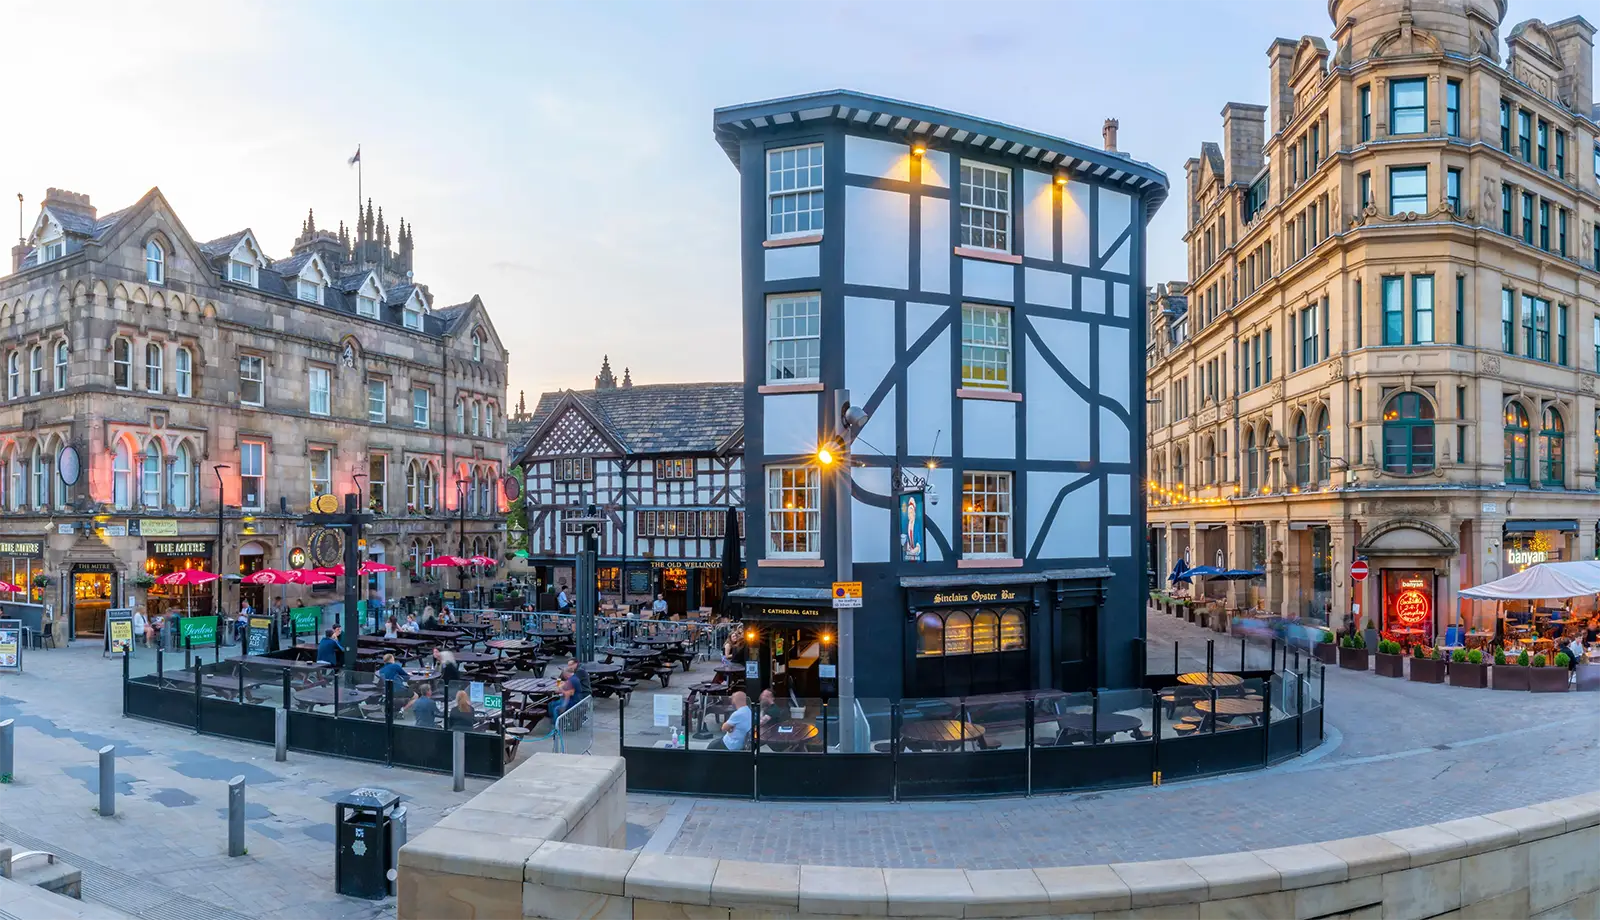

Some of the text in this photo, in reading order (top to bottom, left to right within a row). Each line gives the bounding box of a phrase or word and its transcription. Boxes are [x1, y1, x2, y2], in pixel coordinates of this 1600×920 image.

[0, 543, 39, 553] THE MITRE
[154, 542, 206, 553] THE MITRE
[1508, 549, 1545, 566] banyan
[934, 589, 1016, 604] Sinclairs Oyster Bar
[484, 696, 501, 707] Exit
